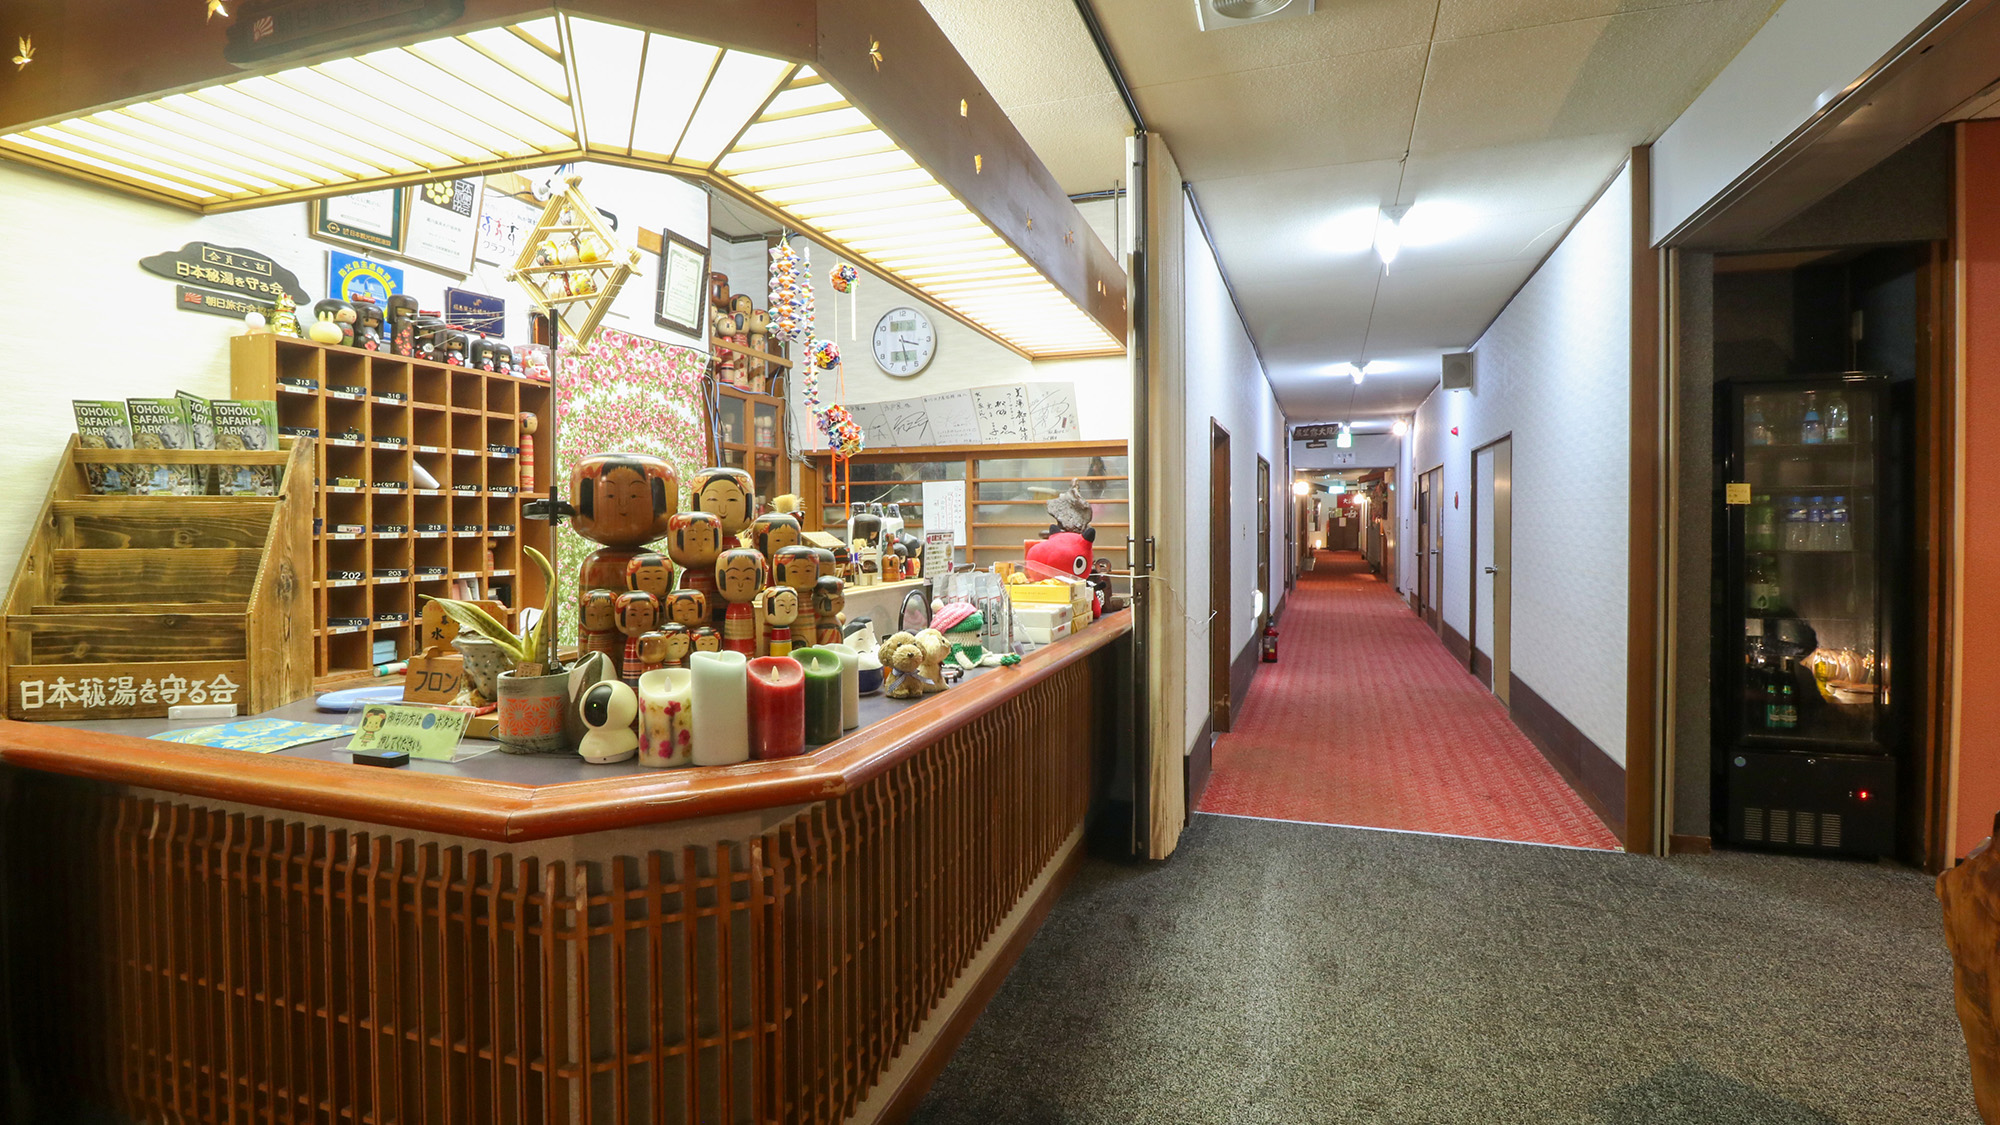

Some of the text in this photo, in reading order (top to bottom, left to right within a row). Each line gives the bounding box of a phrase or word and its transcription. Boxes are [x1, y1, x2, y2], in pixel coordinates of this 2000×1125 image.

[176, 261, 284, 296] 日本秘湯を守る会
[345, 386, 360, 394] 315
[75, 407, 118, 417] TOHOKU
[130, 405, 175, 414] TOHOKU
[213, 406, 257, 416] TOHOKU
[78, 417, 114, 426] SAFARI
[132, 414, 169, 424] SAFARI
[215, 416, 252, 426] SAFARI
[80, 427, 107, 436] PARK
[134, 425, 164, 434] PARK
[217, 427, 245, 436] PARK
[296, 429, 311, 437] 307
[341, 571, 361, 580] 202
[414, 671, 462, 694] フロン
[20, 673, 240, 710] 日本秘湯を守る会
